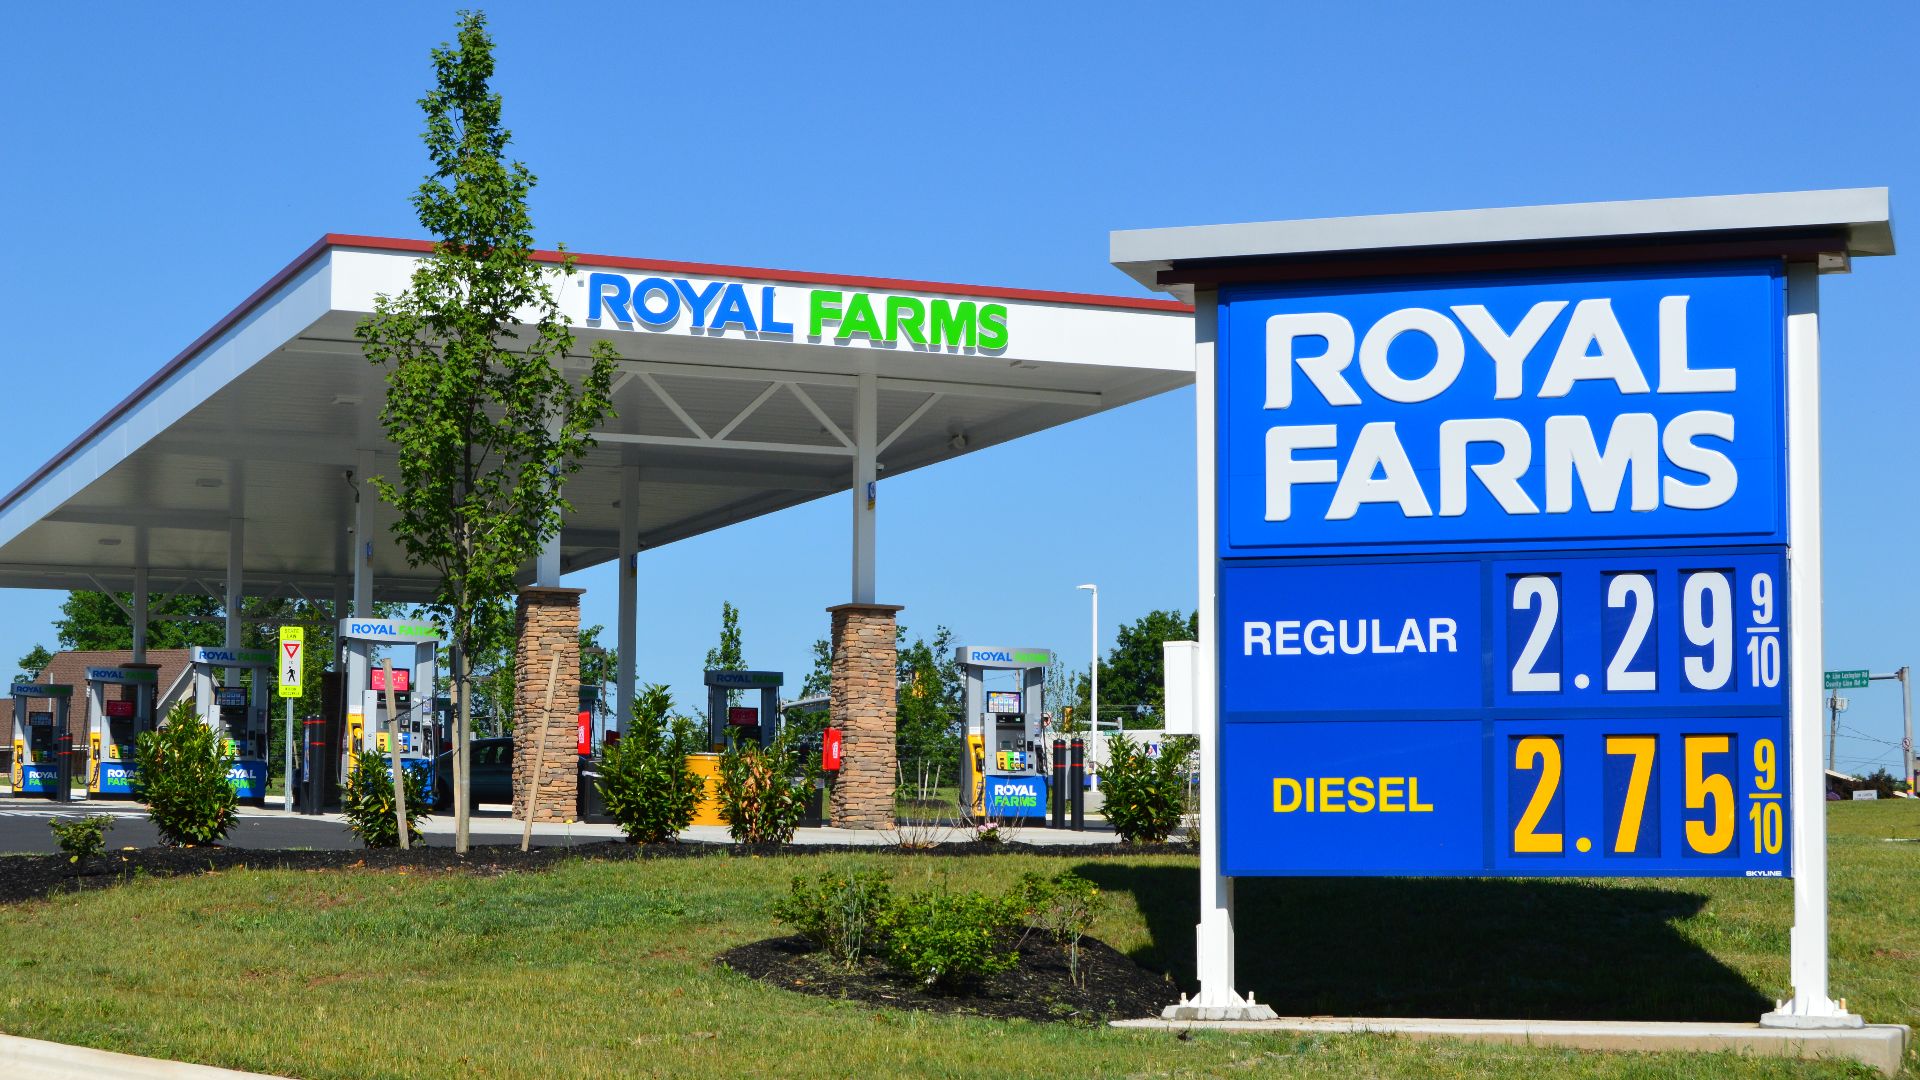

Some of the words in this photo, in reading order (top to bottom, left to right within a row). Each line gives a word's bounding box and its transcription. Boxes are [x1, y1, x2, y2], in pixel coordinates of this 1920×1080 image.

[587, 272, 794, 340] ROYAL
[807, 289, 1009, 354] FARMS
[1263, 295, 1736, 410] ROYAL
[1265, 410, 1738, 522] FARMS
[351, 624, 396, 635] ROYAL
[1243, 617, 1458, 656] REGULAR
[1511, 571, 1733, 692] 2.29
[199, 651, 236, 661] ROYAL
[972, 651, 1013, 662] ROYAL
[92, 670, 124, 679] ROYAL
[716, 674, 752, 684] ROYAL
[16, 685, 44, 693] ROYAL
[29, 770, 58, 779] ROYAL
[107, 769, 135, 778] ROYA
[226, 768, 257, 779] OYAL
[107, 777, 129, 786] FAR
[994, 784, 1038, 796] ROYAL
[1273, 776, 1434, 813] DIESEL
[1514, 735, 1736, 854] 2.75
[994, 795, 1037, 807] FARMS
